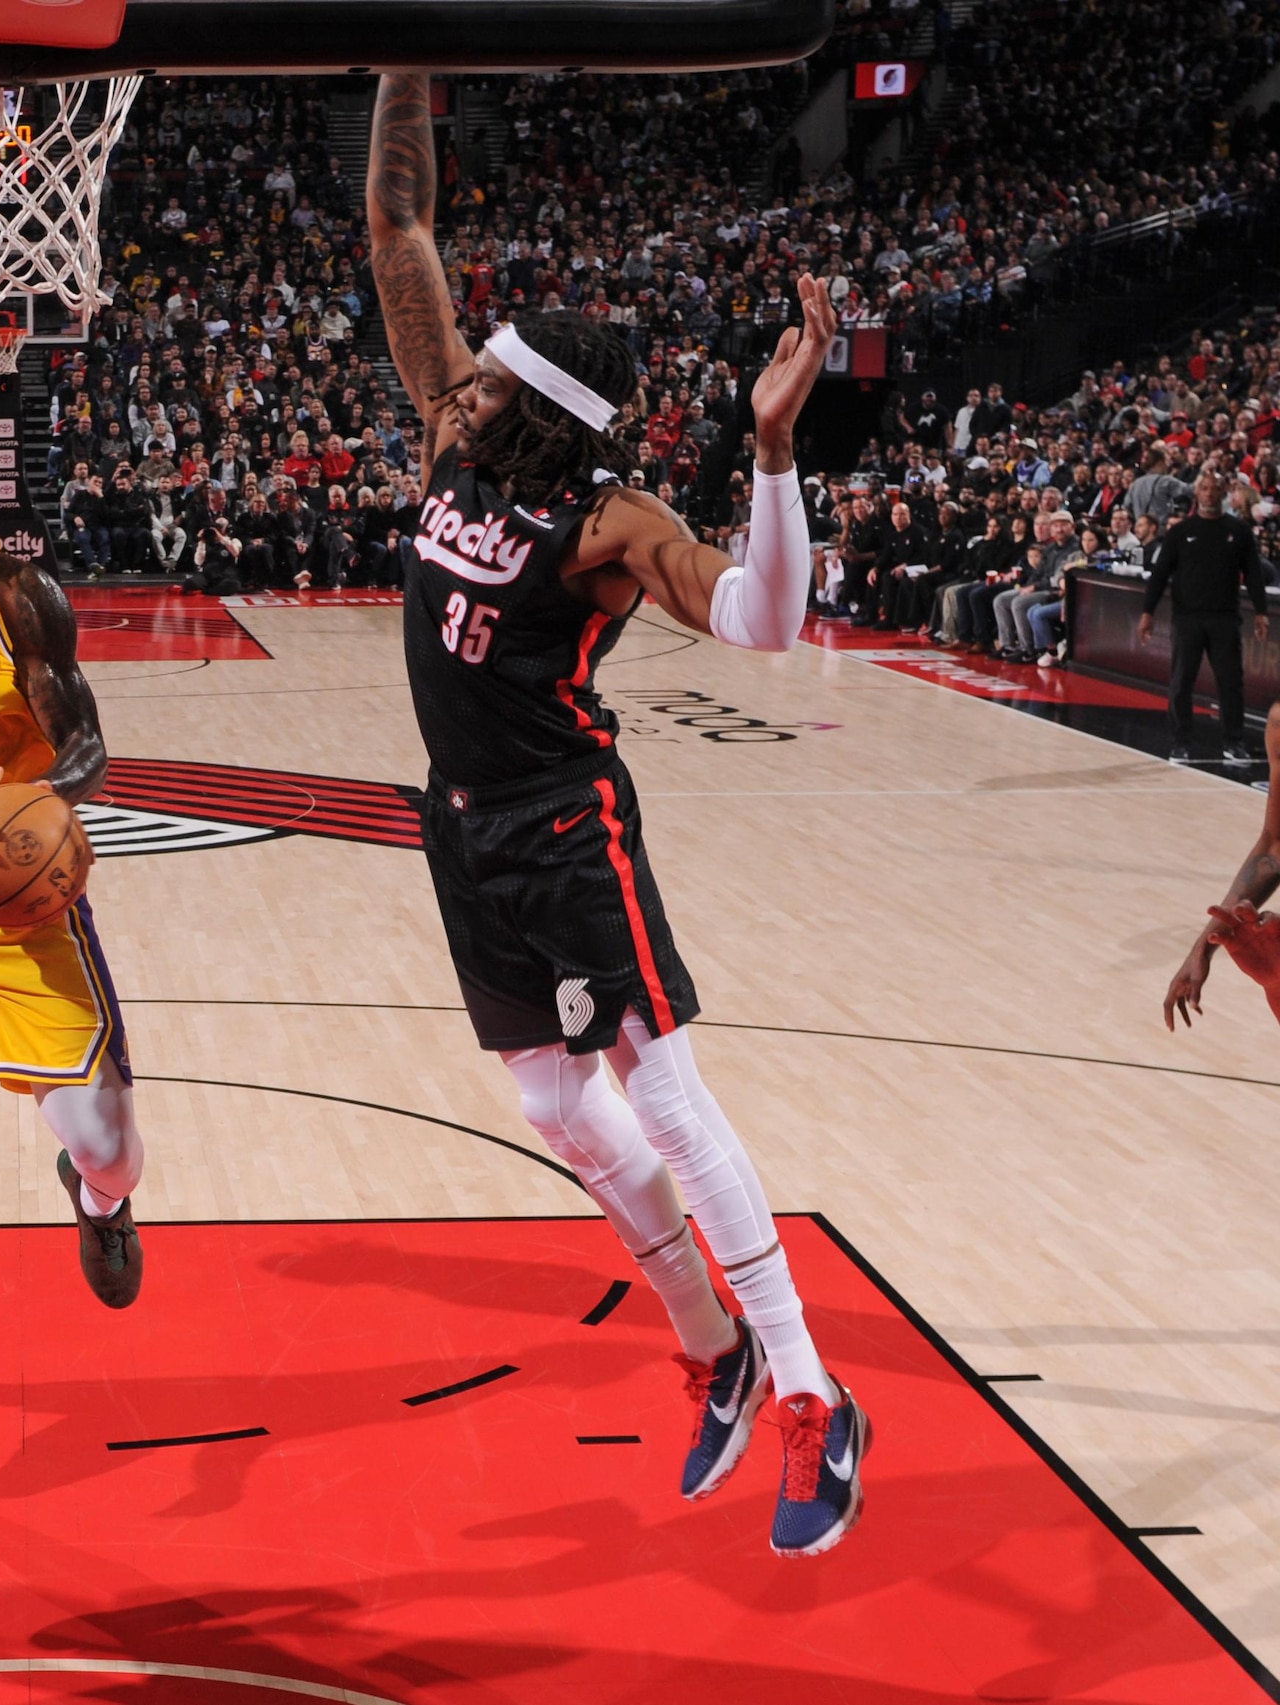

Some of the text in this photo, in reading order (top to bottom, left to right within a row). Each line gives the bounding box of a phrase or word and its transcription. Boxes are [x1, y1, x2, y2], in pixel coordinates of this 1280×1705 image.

[414, 489, 535, 584] ripcity
[441, 591, 501, 664] 35
[614, 689, 803, 743] moda
